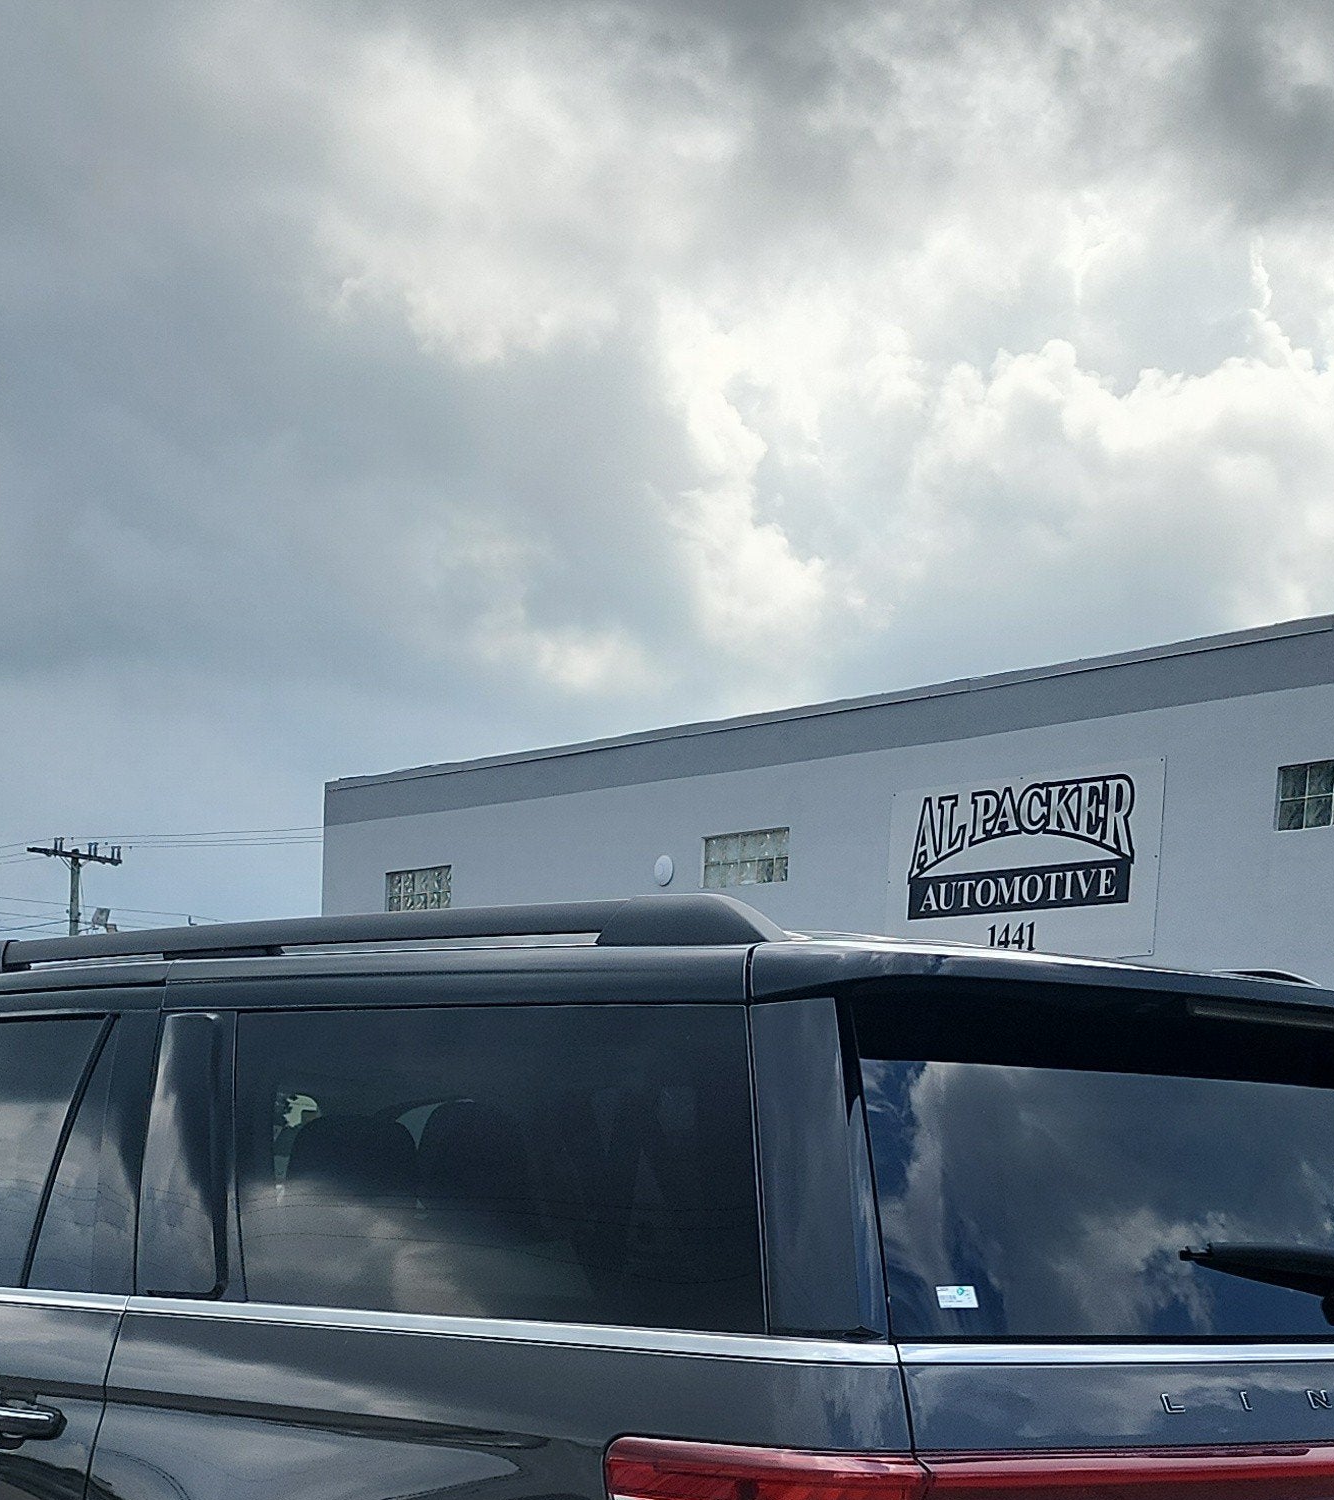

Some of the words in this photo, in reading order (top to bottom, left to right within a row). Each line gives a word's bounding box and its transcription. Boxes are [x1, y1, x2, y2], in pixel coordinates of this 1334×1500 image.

[908, 794, 967, 883] AL
[969, 774, 1134, 861] PACKER
[919, 867, 1117, 912] AUTOMOTIVE
[988, 921, 1036, 951] 1441
